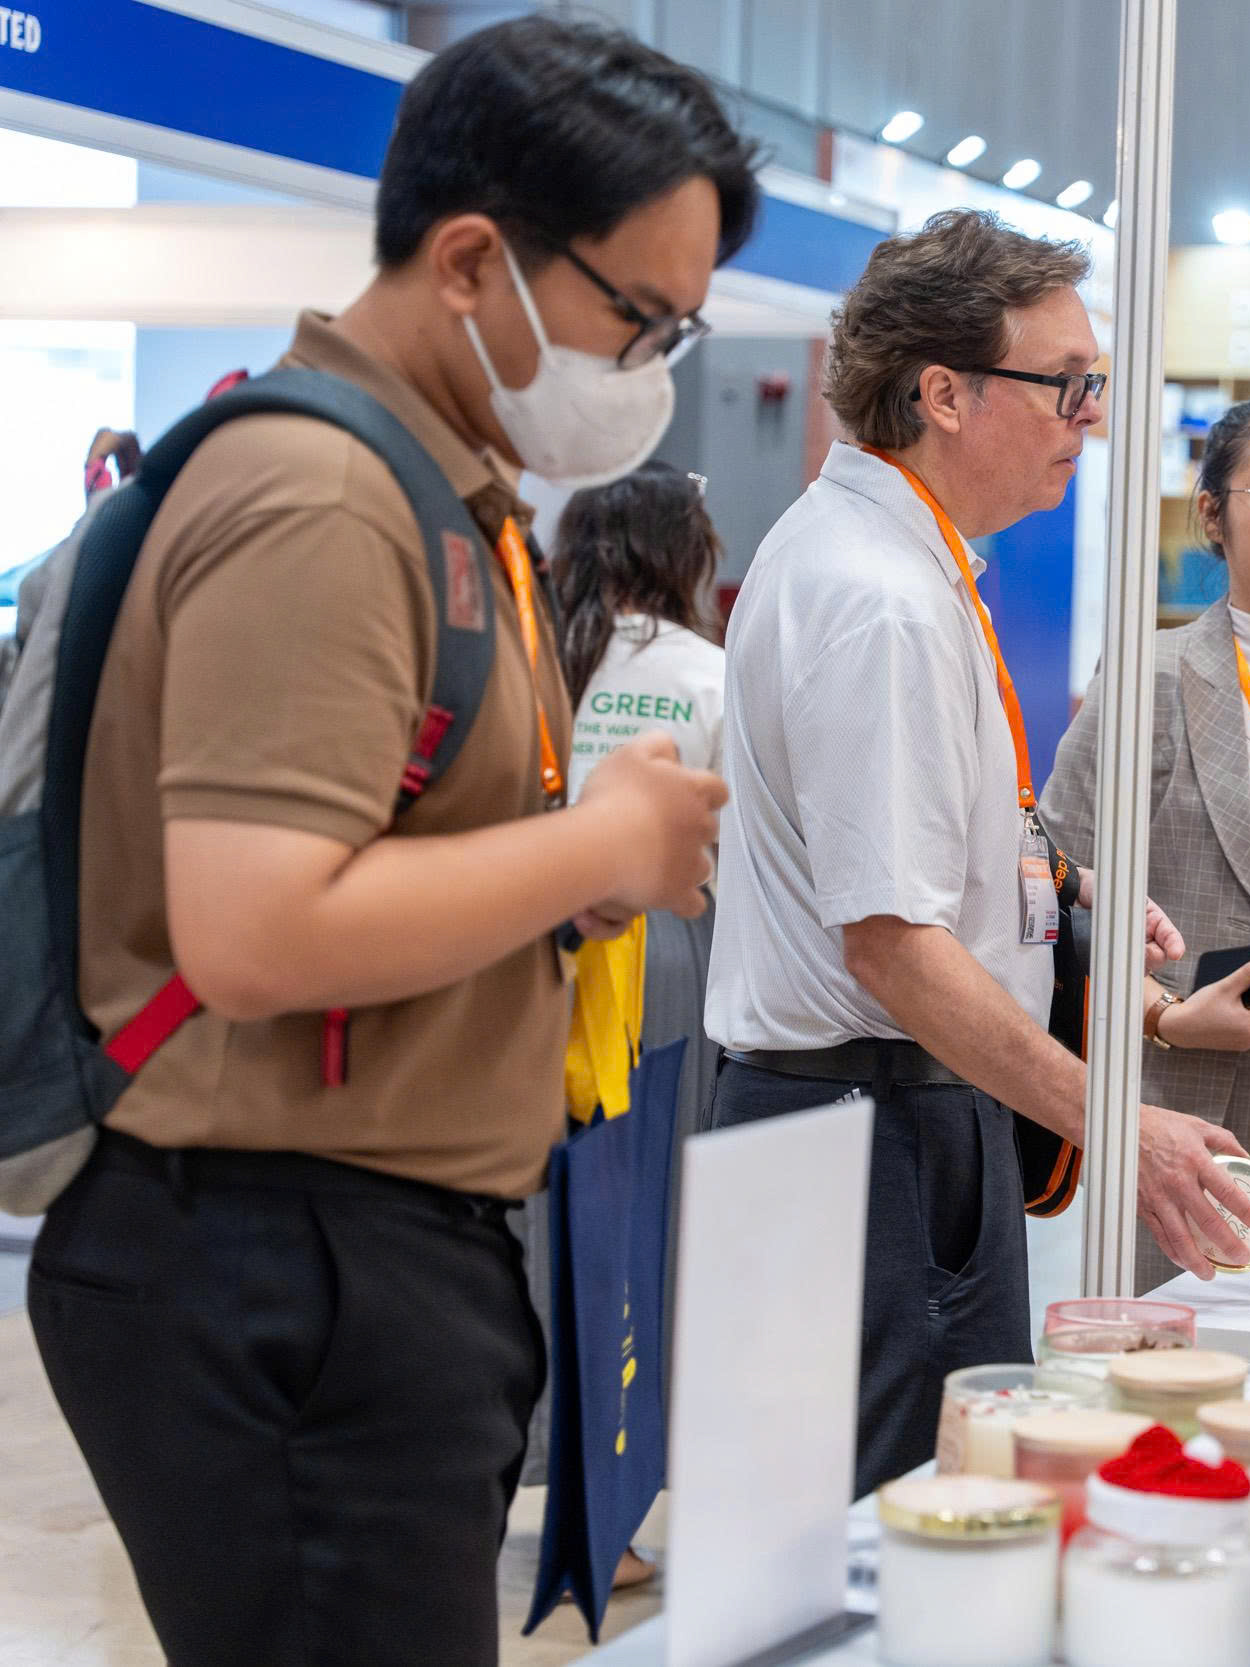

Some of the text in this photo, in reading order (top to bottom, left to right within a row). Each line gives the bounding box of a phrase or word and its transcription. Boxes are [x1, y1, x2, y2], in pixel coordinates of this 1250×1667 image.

[591, 691, 693, 721] GREEN
[576, 722, 640, 736] THE WAY
